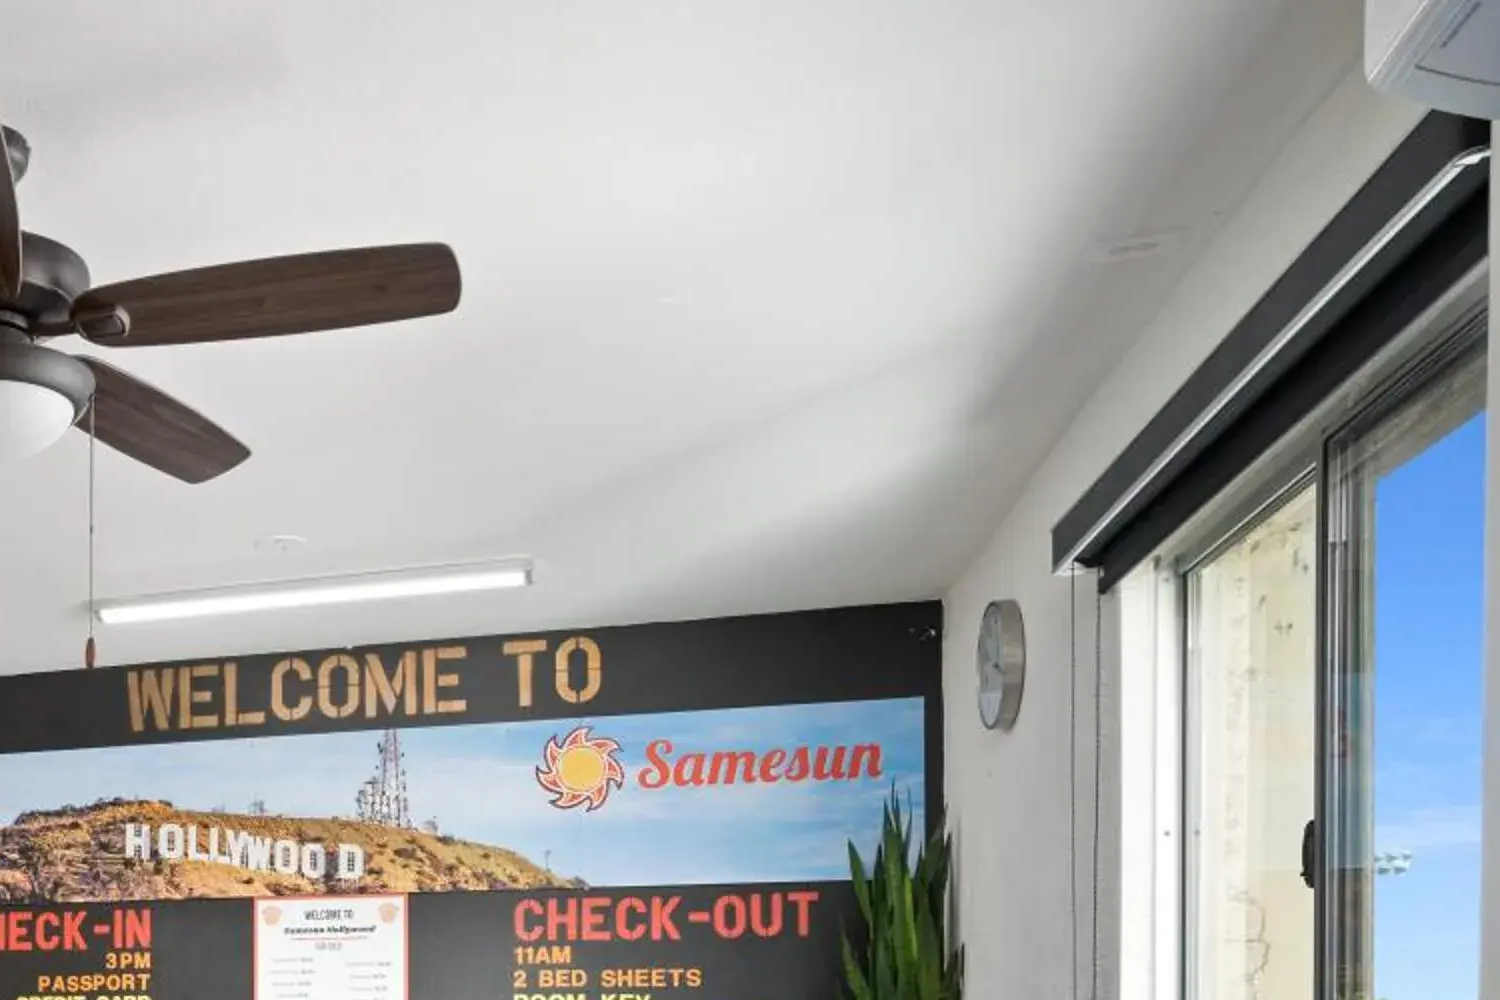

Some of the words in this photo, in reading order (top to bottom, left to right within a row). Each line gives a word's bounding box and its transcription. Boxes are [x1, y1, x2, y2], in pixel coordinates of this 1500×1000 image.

[126, 645, 468, 733] WELCOME
[502, 636, 602, 707] TO
[637, 738, 883, 790] Samesun
[125, 822, 365, 881] HOLLYWOOD
[512, 891, 820, 943] CHECK-OUT
[104, 952, 152, 969] 3PM
[513, 946, 572, 966] 11AM
[37, 974, 152, 993] PASSPORT
[512, 970, 528, 989] 2
[538, 969, 588, 989] BED
[600, 968, 703, 989] SHEETS
